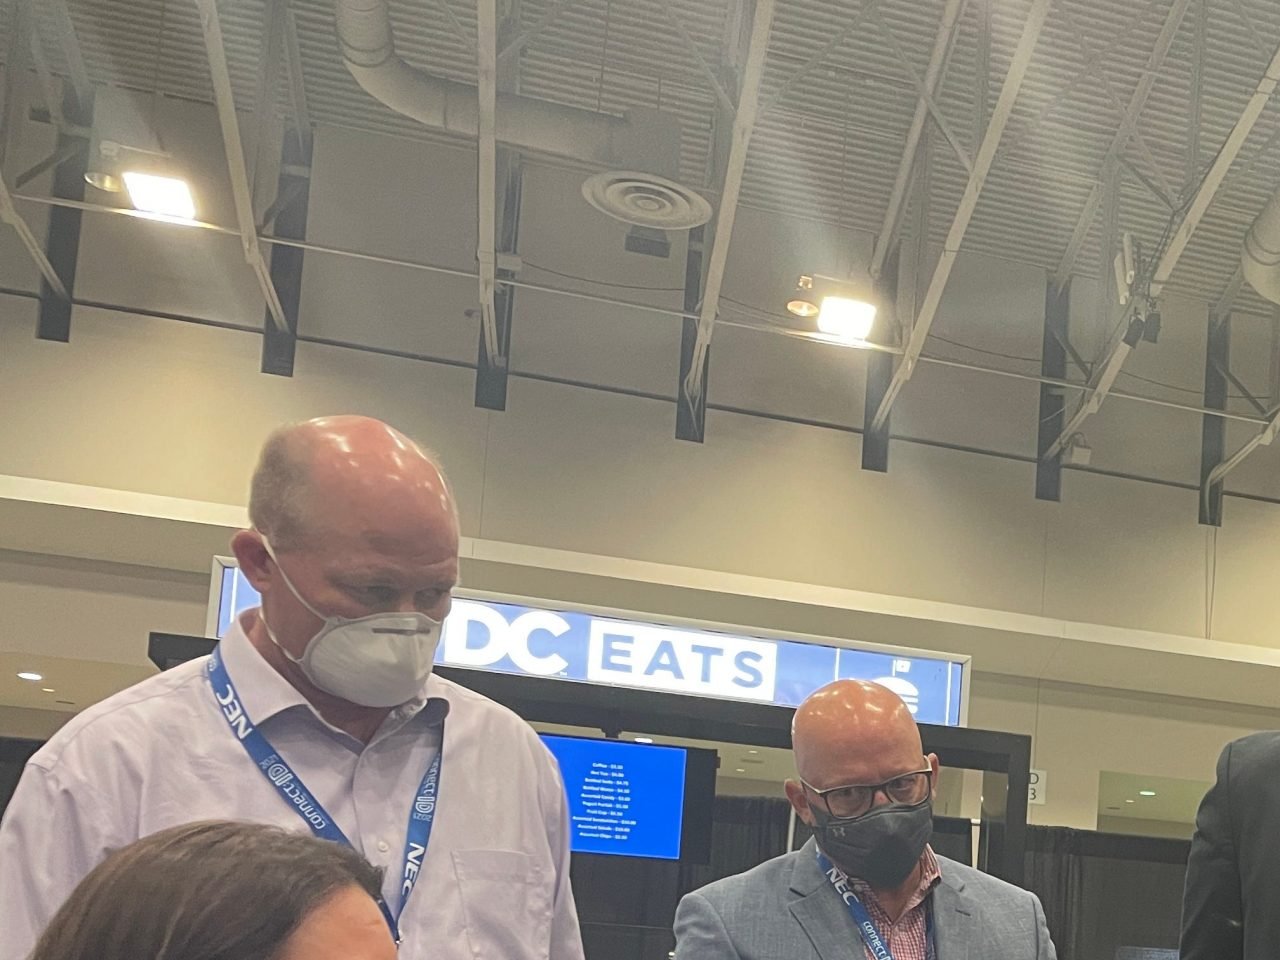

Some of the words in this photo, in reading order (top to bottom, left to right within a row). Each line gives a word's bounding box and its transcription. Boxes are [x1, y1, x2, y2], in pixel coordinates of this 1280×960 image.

[445, 601, 572, 675] DC
[600, 632, 764, 690] EATS
[217, 684, 253, 740] NEC
[402, 843, 425, 897] NEC
[826, 867, 859, 906] NEC
